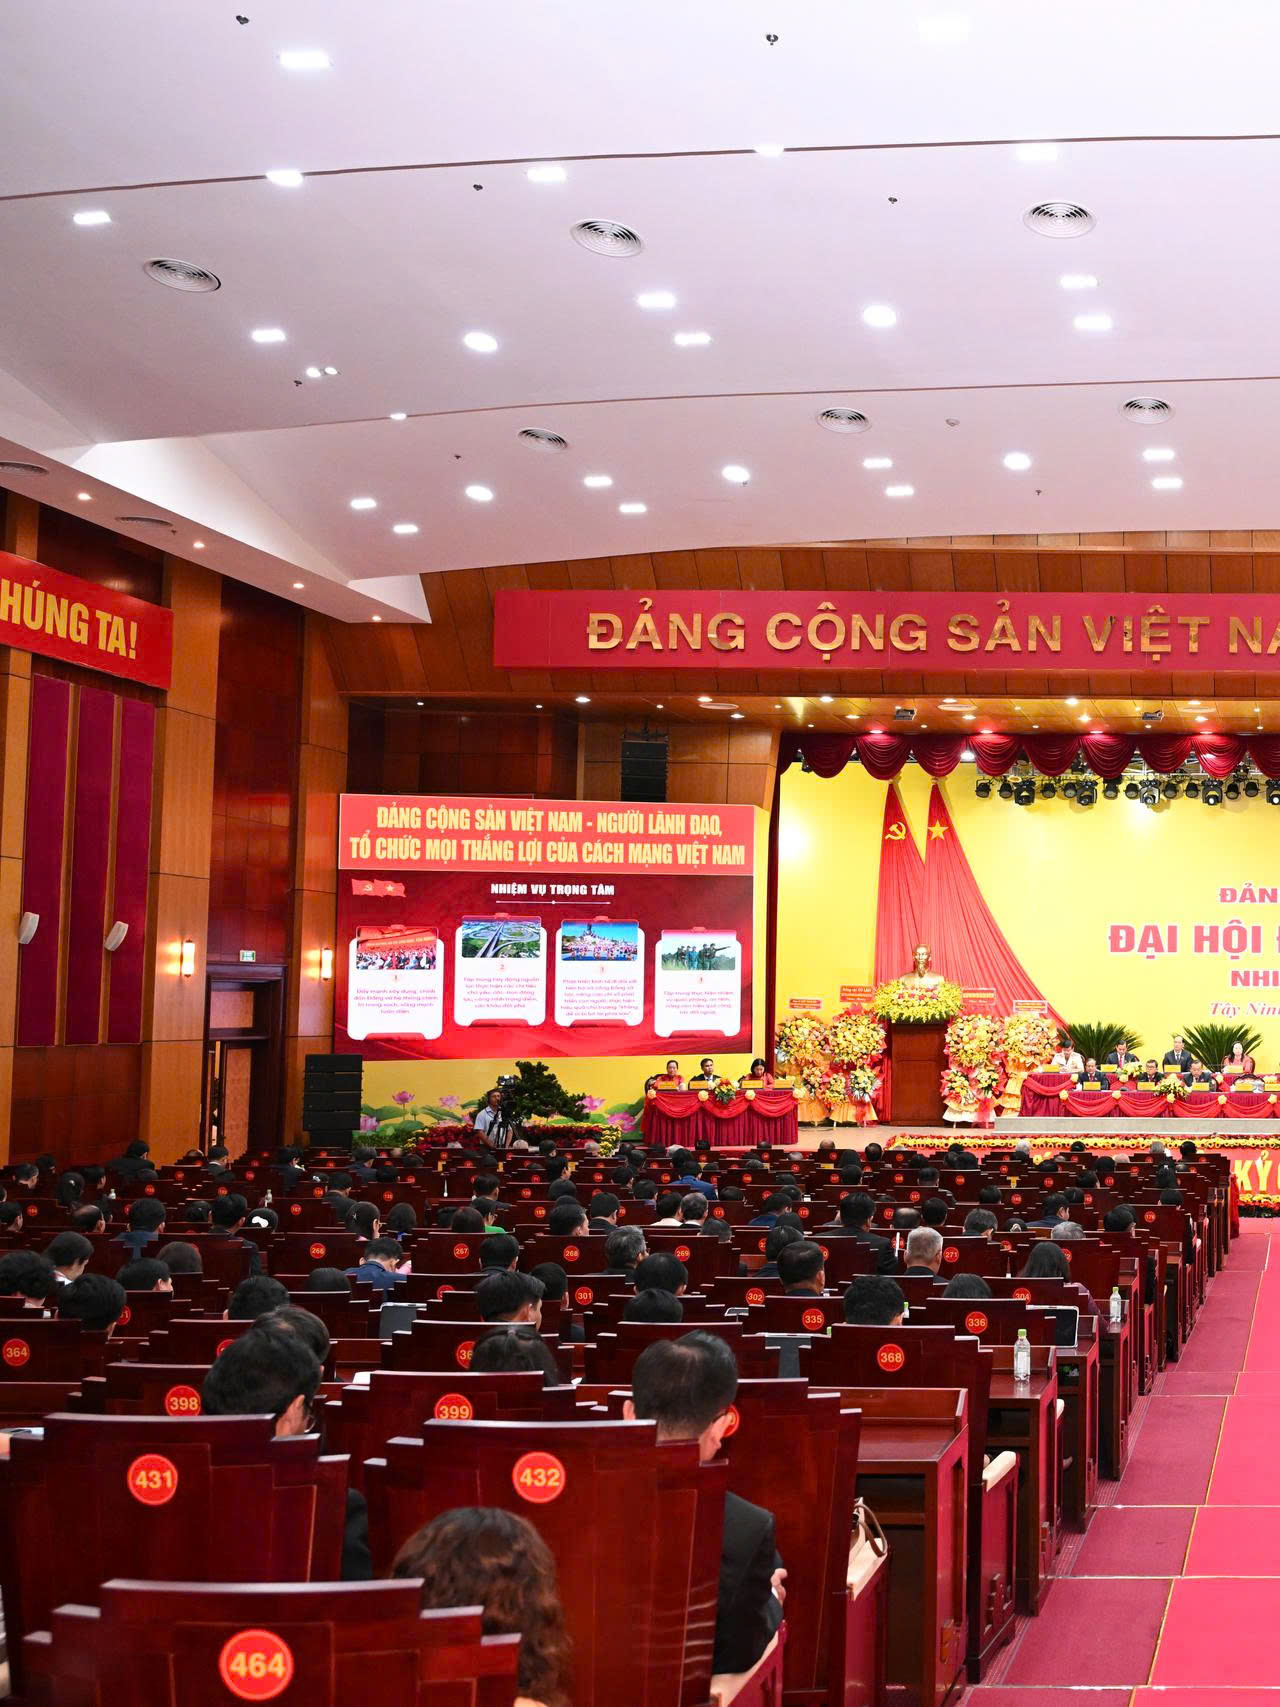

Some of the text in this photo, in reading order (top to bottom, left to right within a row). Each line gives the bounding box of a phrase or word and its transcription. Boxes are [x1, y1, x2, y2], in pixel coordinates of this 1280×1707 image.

[96, 610, 137, 659] TA!
[586, 597, 745, 650] ĐẢNG
[765, 601, 927, 661] CỘNG
[946, 599, 1061, 652] SẢN
[1082, 604, 1210, 661] VIỆT
[376, 801, 422, 829] ĐẢNG
[425, 804, 471, 834] CỘNG
[474, 804, 507, 831] SẢN
[510, 807, 545, 836] VIỆT
[547, 811, 583, 833] NAM
[596, 809, 645, 835] NGƯỜI
[647, 810, 686, 835] LÃNH
[689, 814, 723, 839] ĐẠO,
[349, 830, 746, 869] TỔ CHỨC MỌI THẮNG LỢI CỦA CÁCH MẠNG VIỆT NAM
[490, 882, 615, 897] NHIỆM VỤ TRỌNG TÂM
[1108, 924, 1178, 960] ĐẠI
[1194, 919, 1262, 960] HỘI
[1210, 1002, 1241, 1019] Tây
[1234, 1150, 1272, 1191] KỶ
[577, 1292, 592, 1300] 301
[747, 1293, 763, 1301] 302
[804, 1315, 823, 1324] 335
[967, 1317, 987, 1328] 336
[6, 1347, 28, 1358] 364
[880, 1351, 903, 1363] 368
[170, 1397, 199, 1411] 398
[439, 1404, 470, 1420] 399
[135, 1470, 173, 1489] 431
[519, 1467, 561, 1488] 432
[230, 1652, 287, 1679] 464
